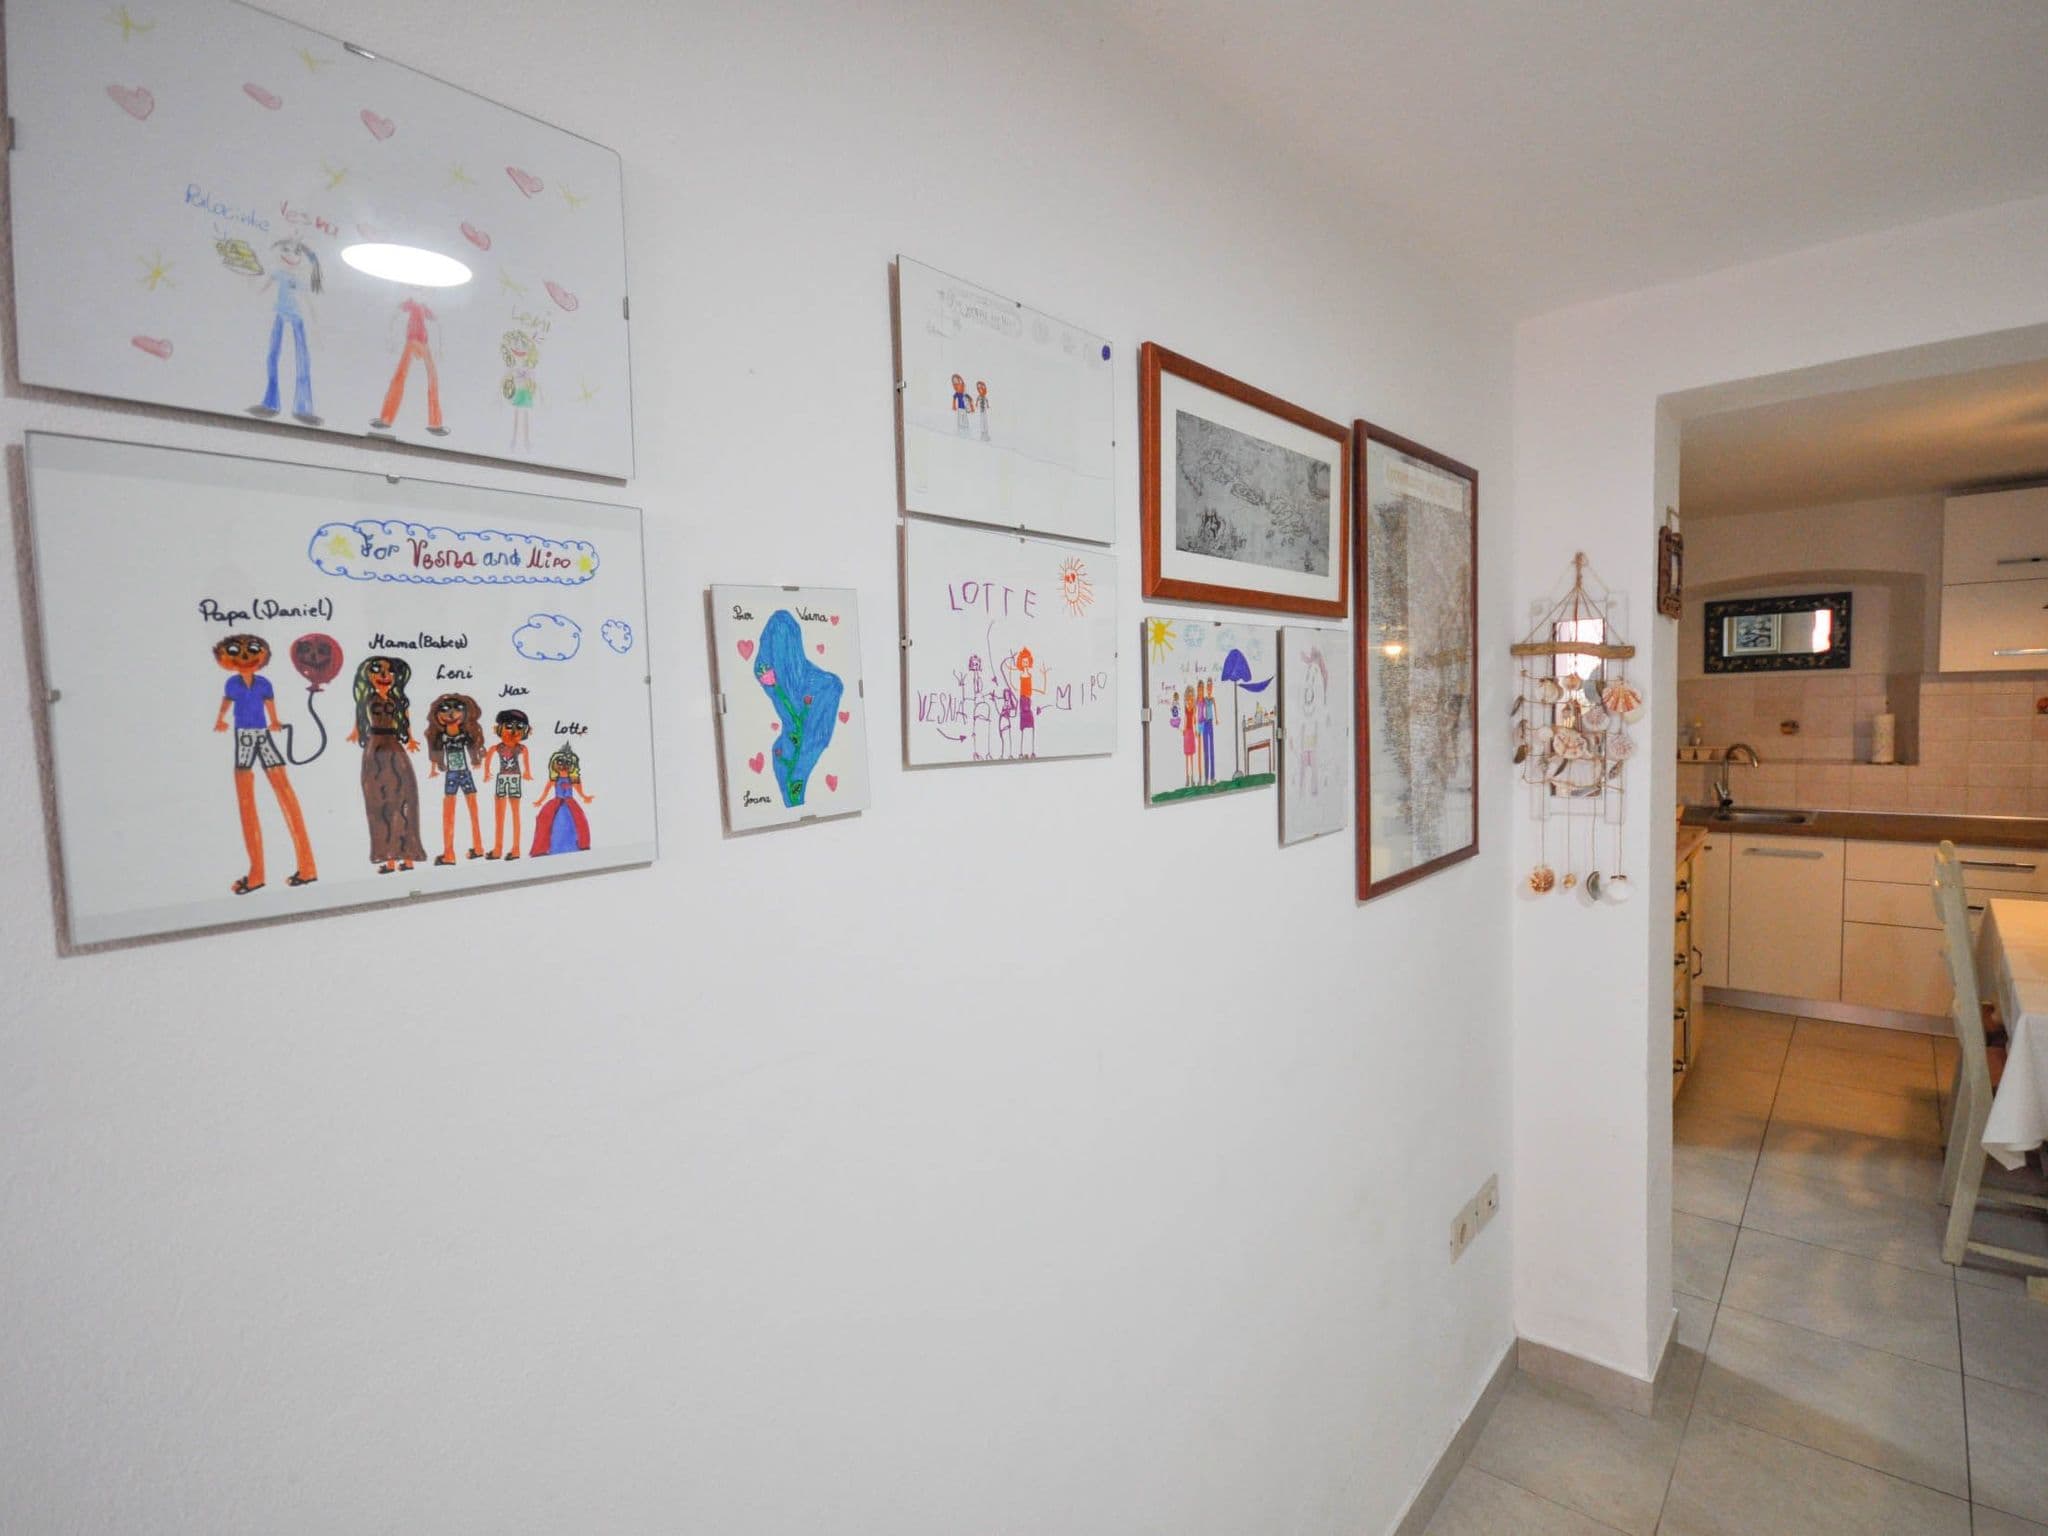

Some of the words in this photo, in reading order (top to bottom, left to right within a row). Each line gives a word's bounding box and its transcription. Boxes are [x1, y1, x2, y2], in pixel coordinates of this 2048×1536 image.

[361, 534, 399, 560] For
[407, 538, 477, 568] Vesna
[483, 549, 521, 567] and
[526, 548, 572, 569] Miro
[949, 581, 1038, 618] LOTTE
[498, 683, 530, 698] Max
[917, 690, 968, 724] VESNA
[1056, 671, 1108, 711] MIRO
[554, 720, 589, 735] Lotte
